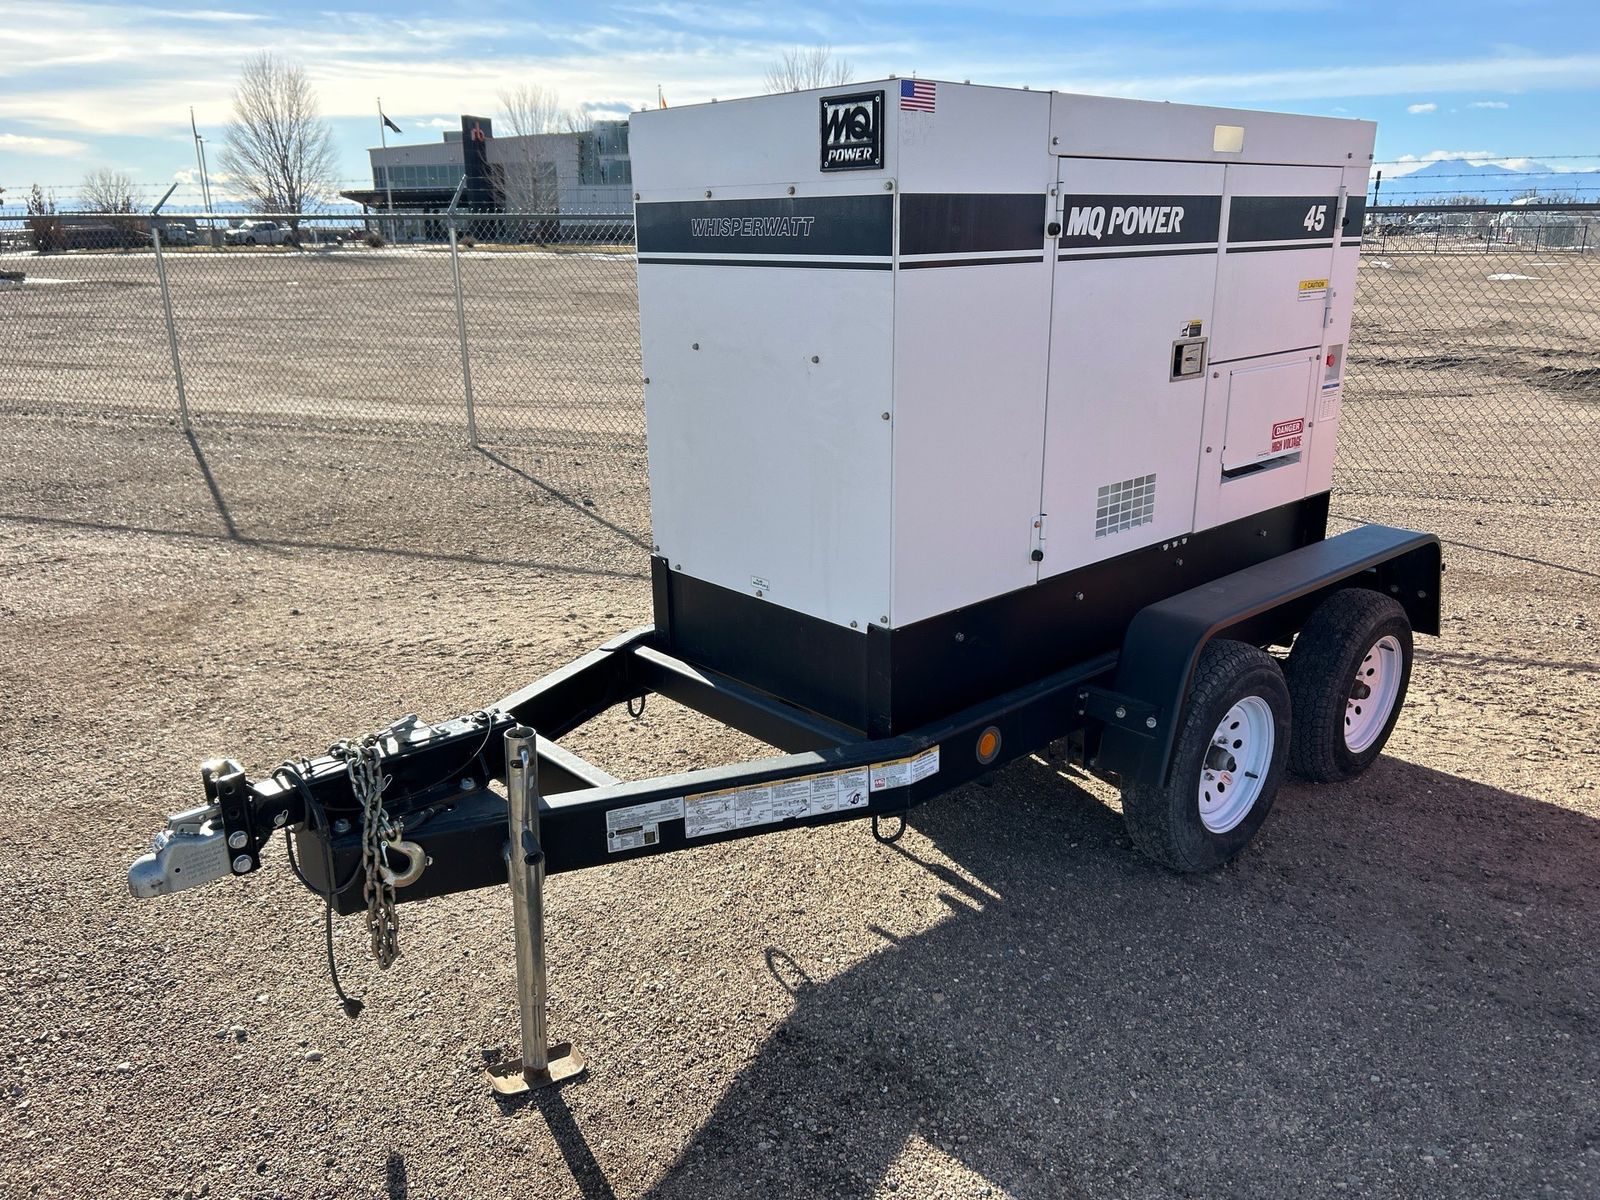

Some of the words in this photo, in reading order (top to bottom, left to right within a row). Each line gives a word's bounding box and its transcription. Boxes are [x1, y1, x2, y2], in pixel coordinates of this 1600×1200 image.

[825, 105, 874, 141] MQ
[827, 147, 872, 162] POWER
[691, 216, 815, 237] WHISPERWATT
[1066, 206, 1106, 239] MQ
[1107, 206, 1184, 235] POWER
[1303, 205, 1327, 231] 45
[1307, 281, 1325, 289] CAUTION
[1276, 423, 1300, 435] DANGER
[1272, 440, 1283, 453] HIGH
[1284, 436, 1302, 450] VOLTAGE
